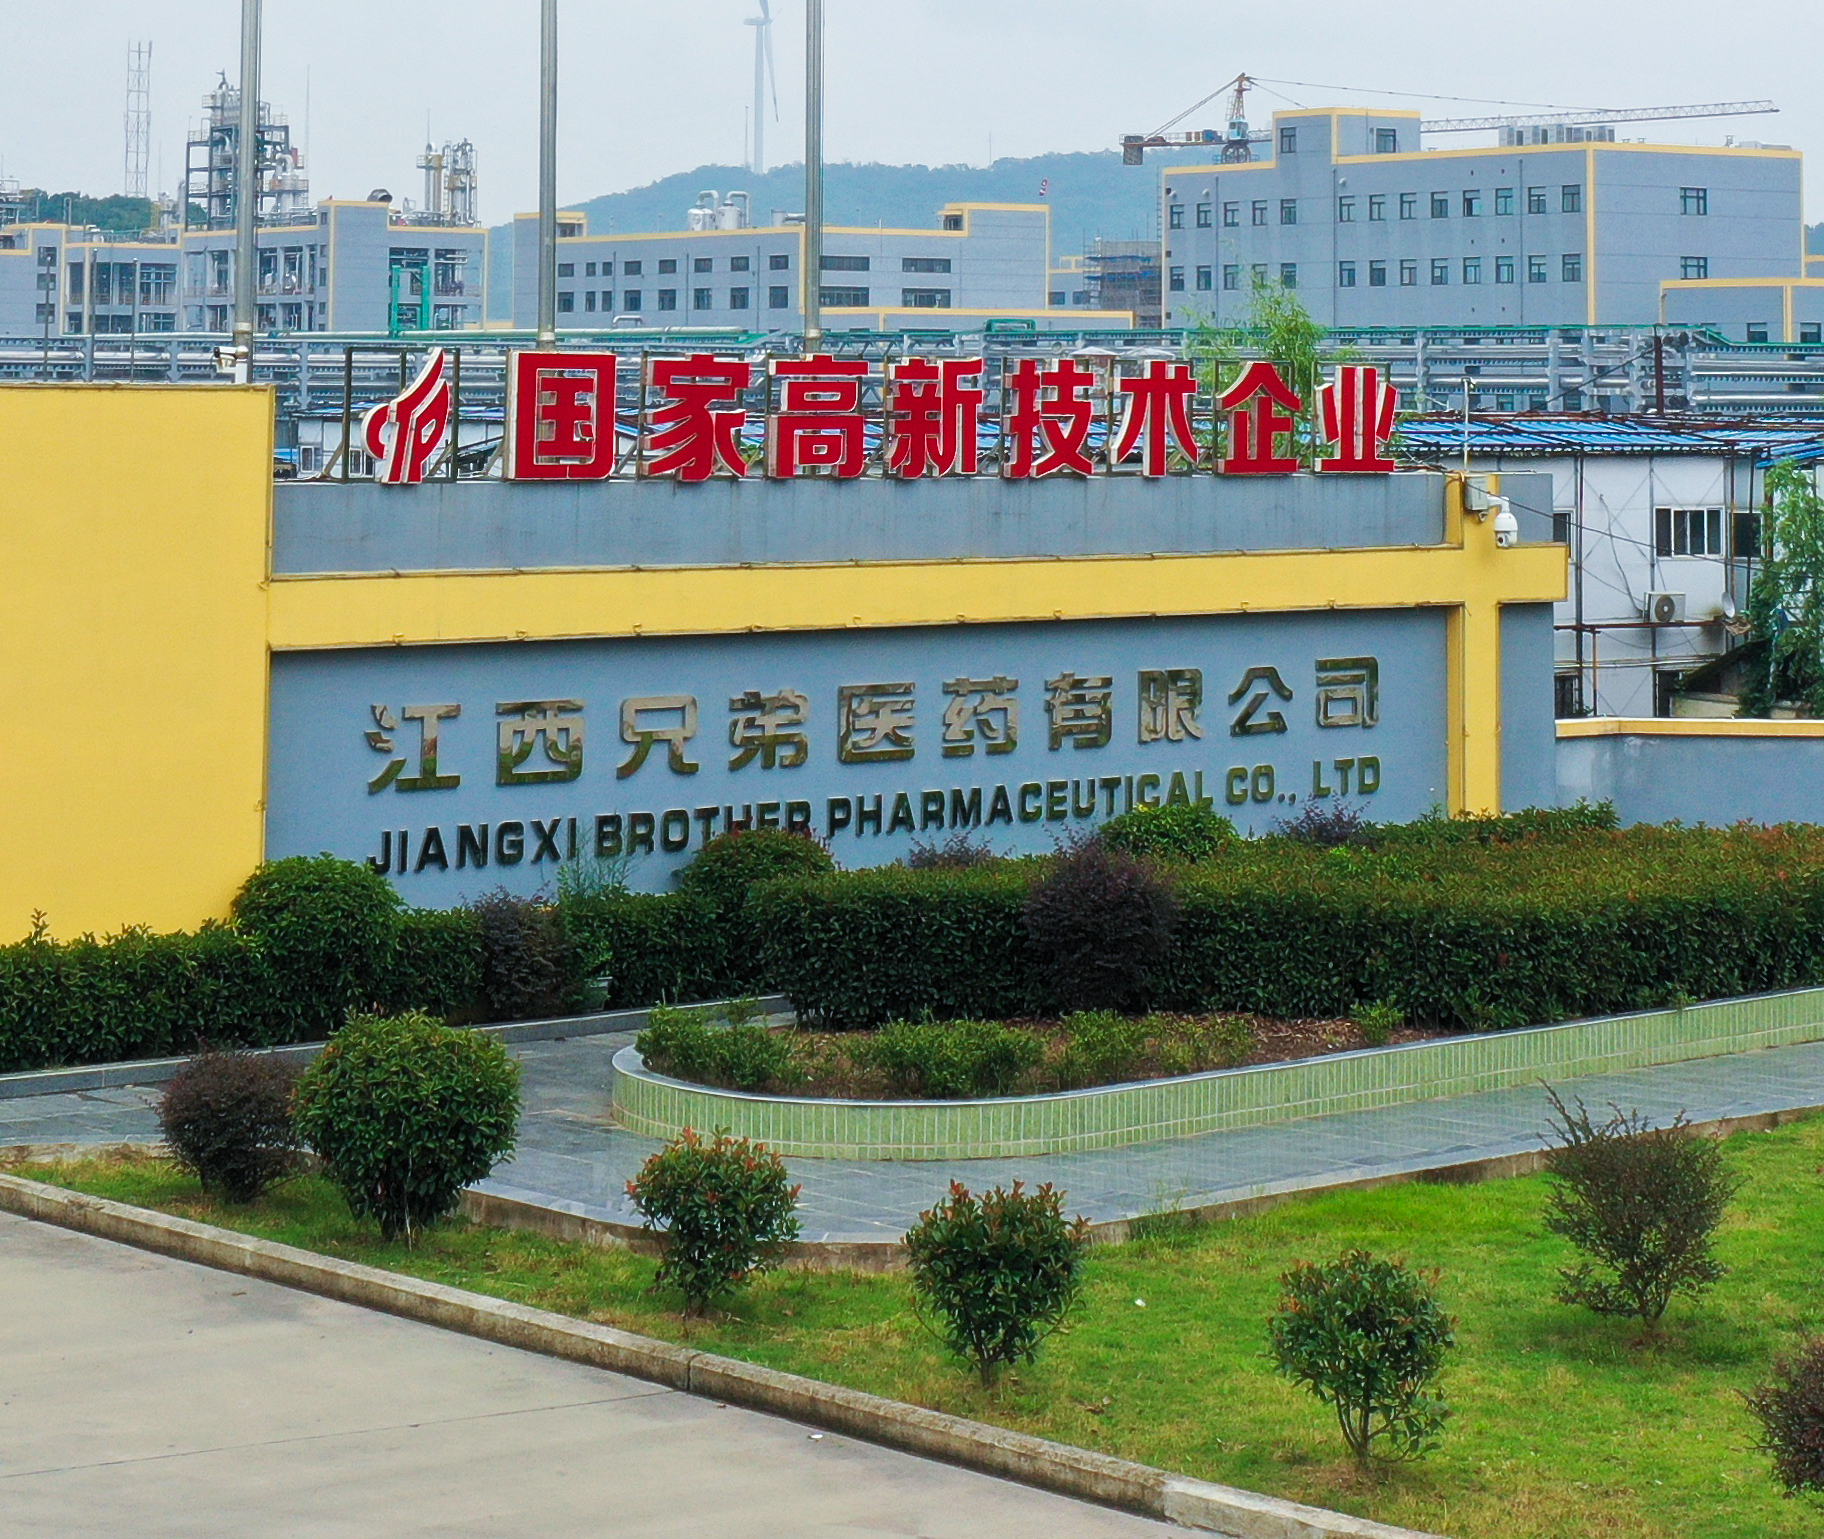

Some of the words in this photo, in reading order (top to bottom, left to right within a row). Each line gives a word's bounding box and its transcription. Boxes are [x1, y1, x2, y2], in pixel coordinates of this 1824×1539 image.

[506, 353, 1398, 482] 国家高新技术企业
[365, 656, 1379, 794] 江西兄弟医药有限公司
[367, 817, 577, 875] JIANGXI
[826, 769, 1213, 837] PHARMACEUTICAL
[1226, 764, 1297, 805] CO.,
[1312, 755, 1381, 797] LTD
